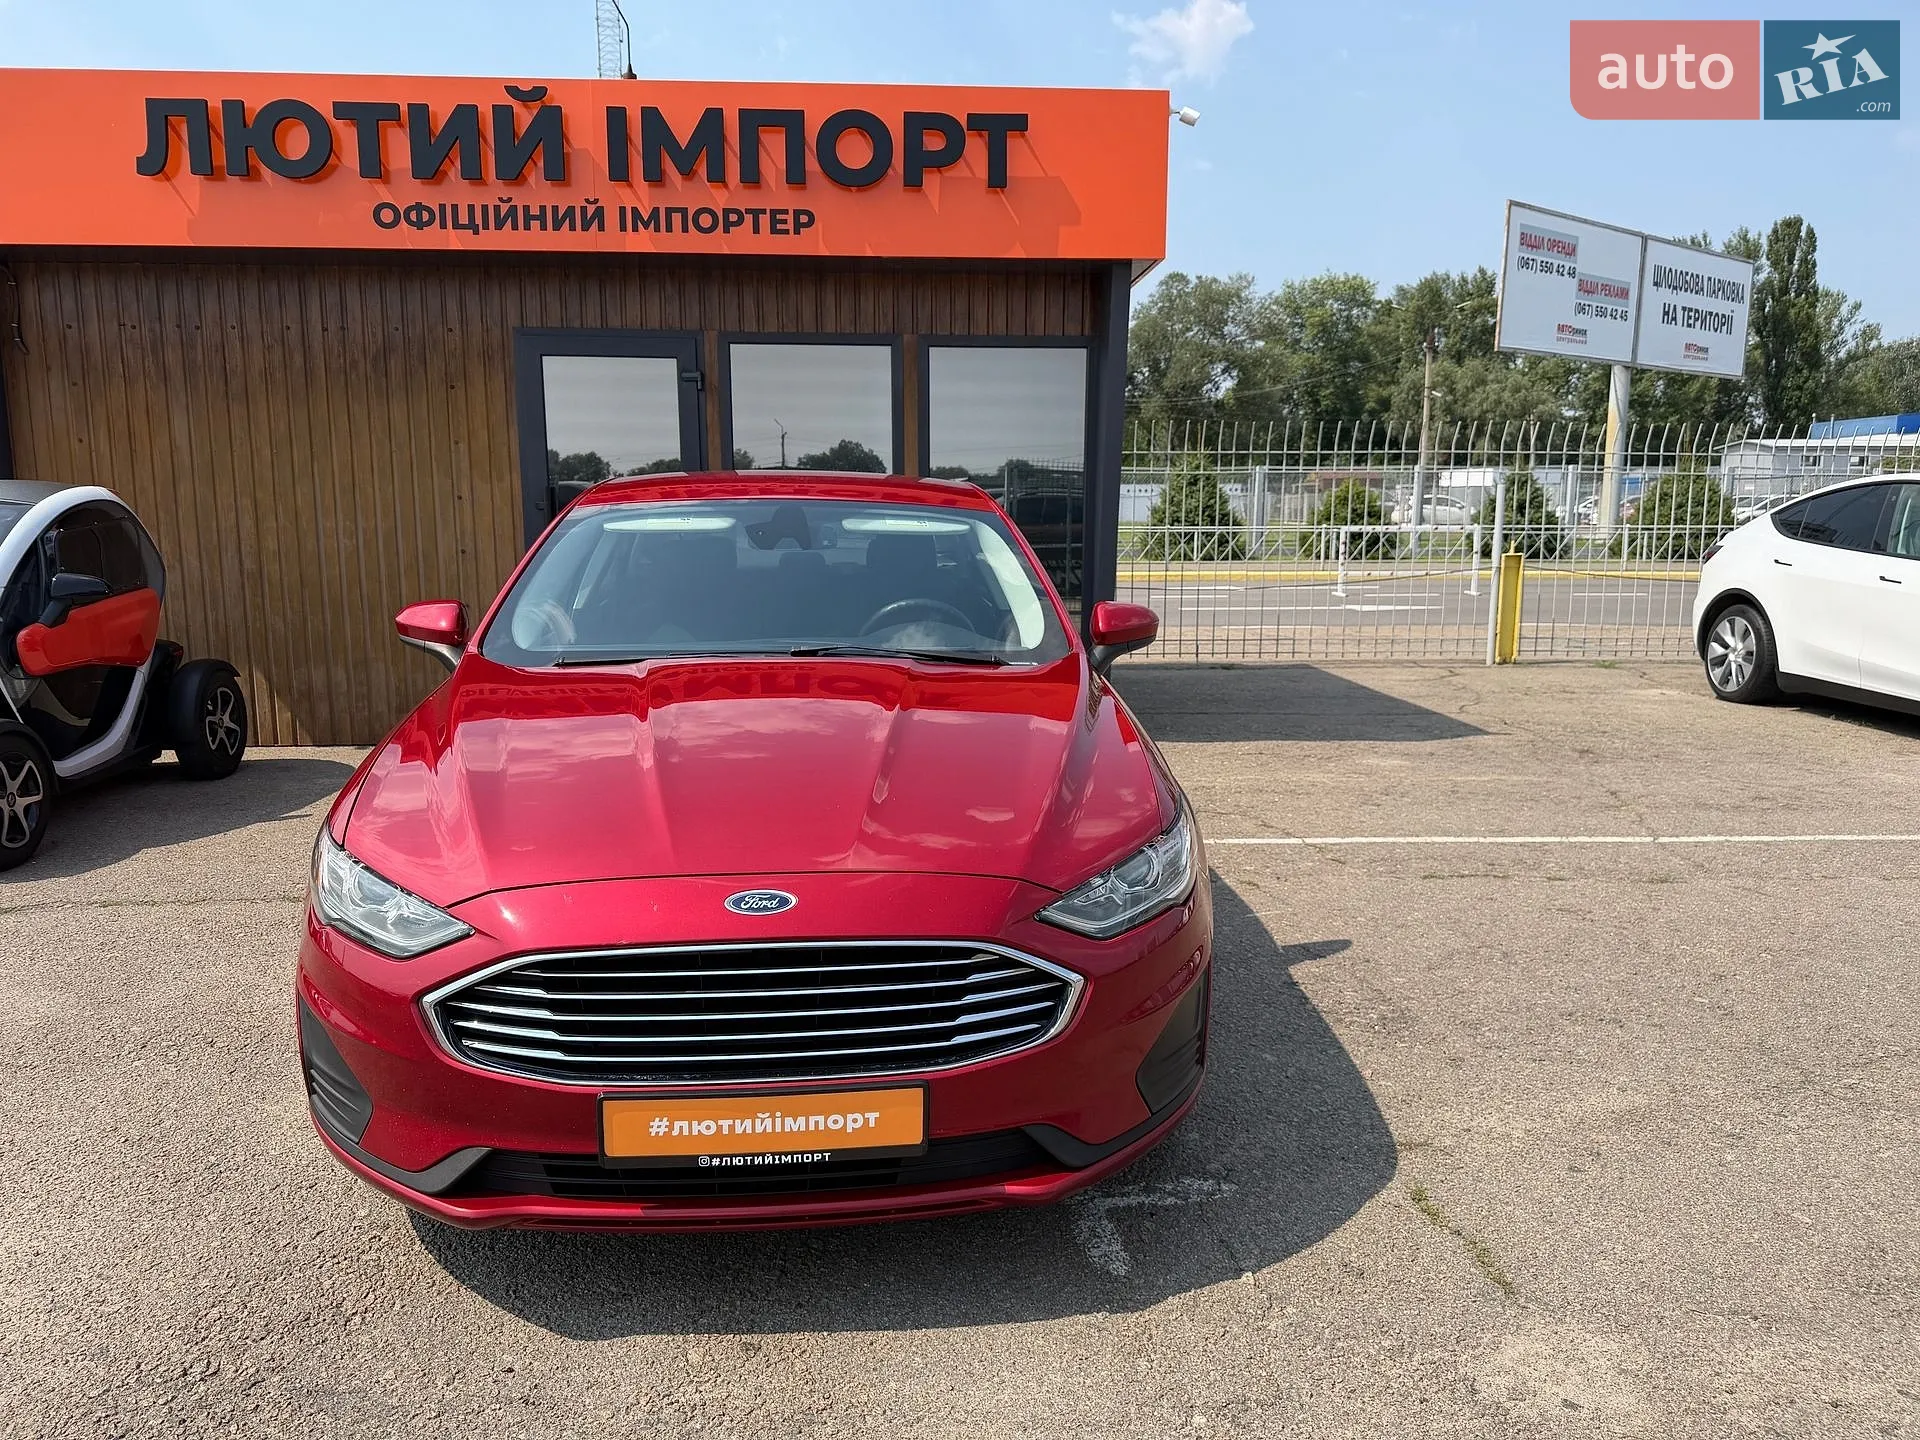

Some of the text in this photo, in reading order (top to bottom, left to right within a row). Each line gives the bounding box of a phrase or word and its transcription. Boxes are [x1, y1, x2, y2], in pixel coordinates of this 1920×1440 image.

[136, 85, 1028, 188] ЛЮТИЙ ІМПОРТ
[372, 197, 815, 235] ОФІЦІЙНИЙ ІМПОРТЕР
[1520, 232, 1577, 258] ВІДДІЛ ОРЕНДИ
[1517, 256, 1577, 279] (067) 550 42 48
[1577, 279, 1630, 301] ВІДДІЛ РЕКЛАМИ
[1652, 264, 1745, 304] ЦІЛОДОБОВА ПАРКОВКА
[1574, 302, 1628, 322] (067) 550 42 45
[1662, 302, 1735, 336] НА ТЕРИТОРІЇ
[648, 1111, 880, 1137] #лютийімпорт
